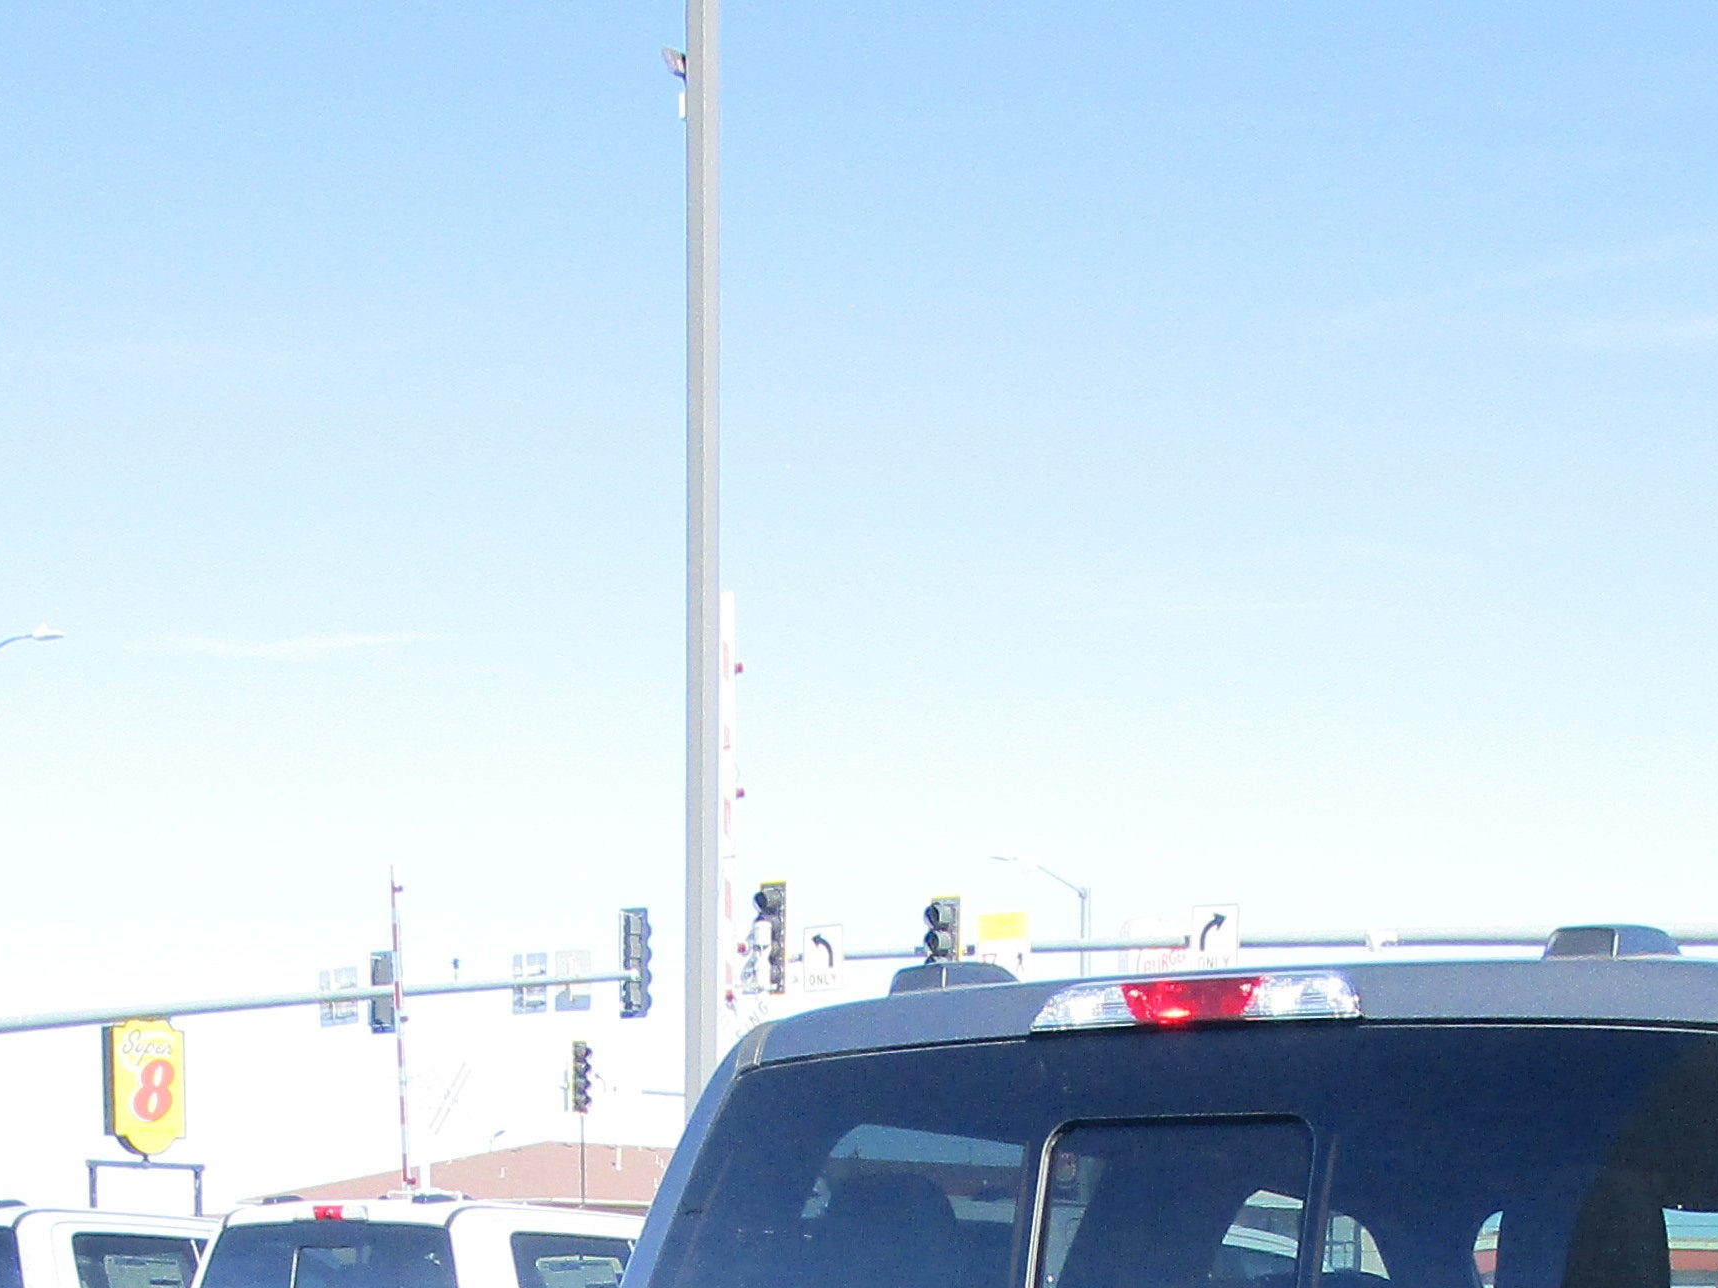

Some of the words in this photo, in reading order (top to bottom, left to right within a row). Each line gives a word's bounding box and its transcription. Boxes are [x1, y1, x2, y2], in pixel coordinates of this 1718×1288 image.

[808, 974, 836, 986] ONLY
[122, 1029, 174, 1067] Super
[133, 1058, 176, 1122] 8
